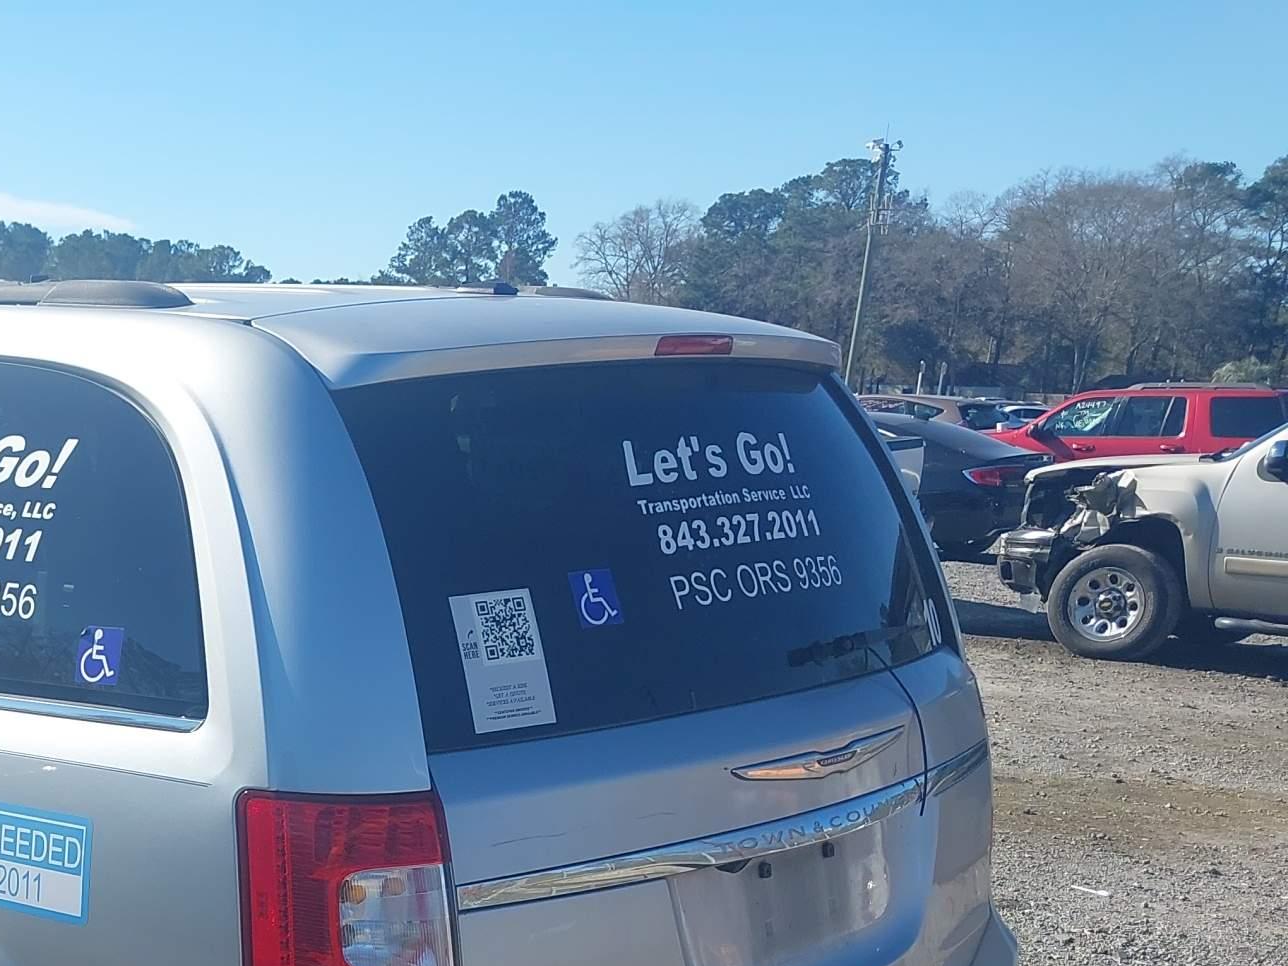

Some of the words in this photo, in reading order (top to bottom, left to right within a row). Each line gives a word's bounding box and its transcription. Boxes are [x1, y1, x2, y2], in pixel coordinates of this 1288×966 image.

[622, 437, 727, 487] Let's
[736, 431, 794, 477] Go!
[22, 501, 56, 520] LLC
[637, 488, 740, 516] Transportation
[743, 485, 786, 502] Service
[790, 483, 811, 500] LLC
[657, 508, 821, 555] 843.327.2011
[669, 568, 732, 610] PSC
[736, 560, 793, 598] ORS
[793, 554, 843, 589] 9356
[923, 598, 941, 647] 10
[461, 641, 479, 652] SCAN
[464, 650, 480, 660] HERE
